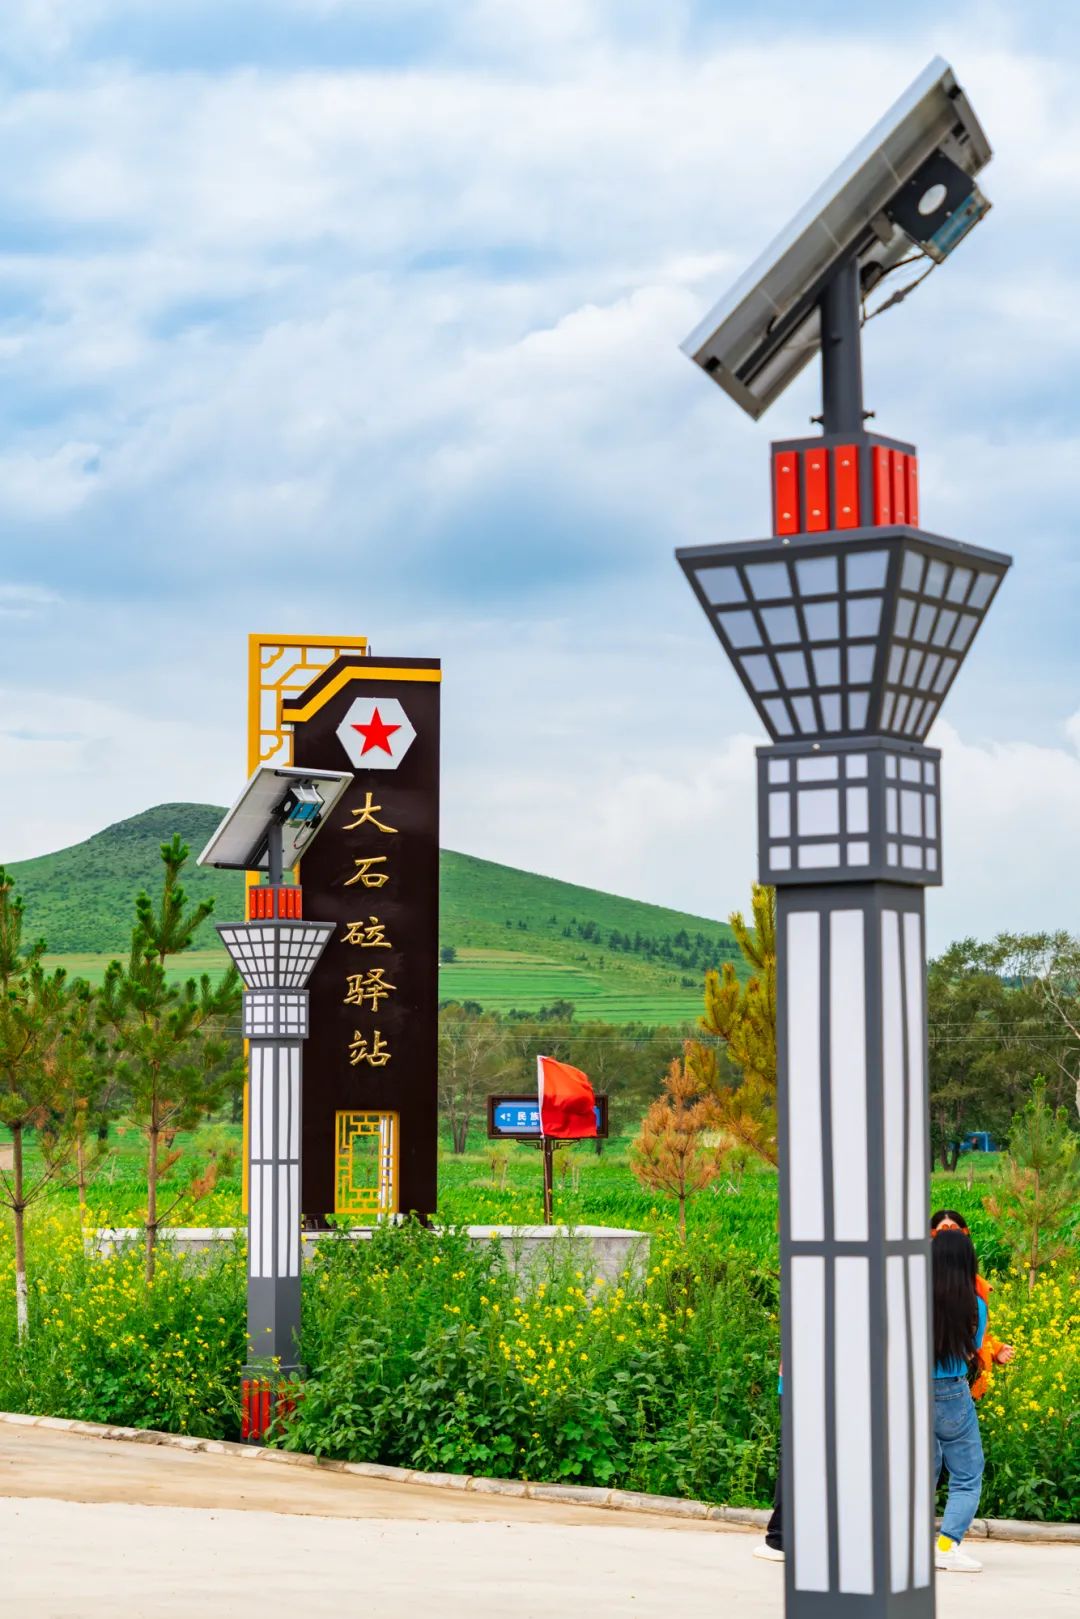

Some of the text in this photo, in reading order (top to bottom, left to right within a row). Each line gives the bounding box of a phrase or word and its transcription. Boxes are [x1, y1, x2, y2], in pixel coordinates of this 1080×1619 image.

[341, 792, 398, 1067] 大石砬驿站
